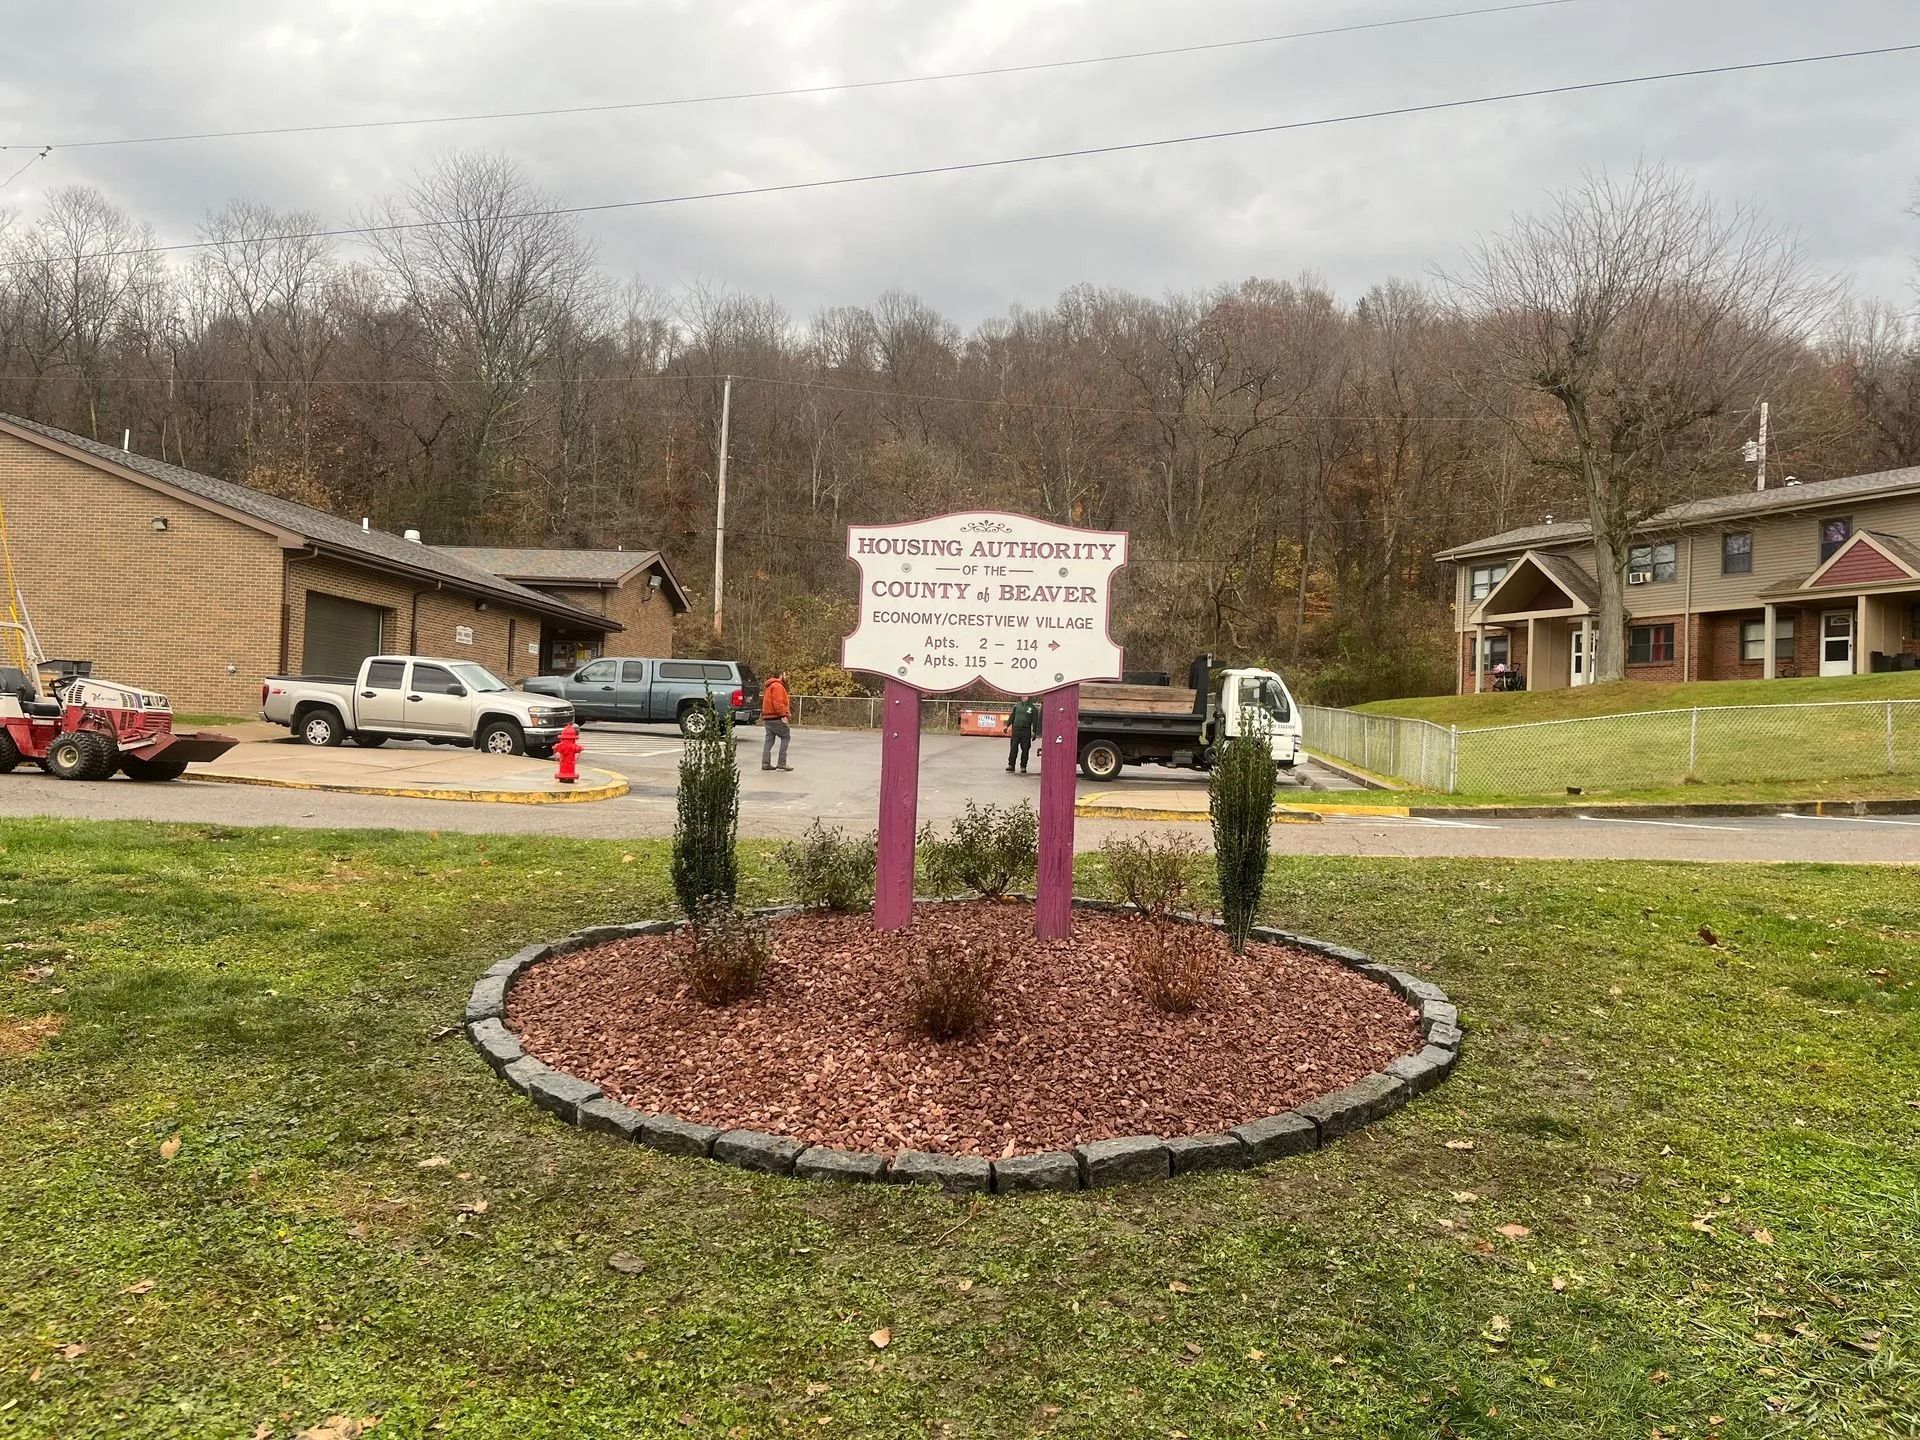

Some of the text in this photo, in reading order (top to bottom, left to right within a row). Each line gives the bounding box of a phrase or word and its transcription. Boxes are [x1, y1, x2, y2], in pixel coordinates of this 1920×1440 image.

[857, 537, 1116, 560] HOUSING AUTHORITY
[962, 564, 1007, 577] OF THE
[871, 580, 1097, 603] COUNTY of BEAVER
[873, 611, 1094, 630] ECONOMY/CRESTVIEW VILLAGE
[924, 635, 959, 650] Apts.
[979, 637, 988, 650] 2
[1016, 639, 1038, 651] 114
[923, 654, 958, 668] Apts.
[964, 655, 987, 668] 115
[1010, 657, 1038, 670] 200
